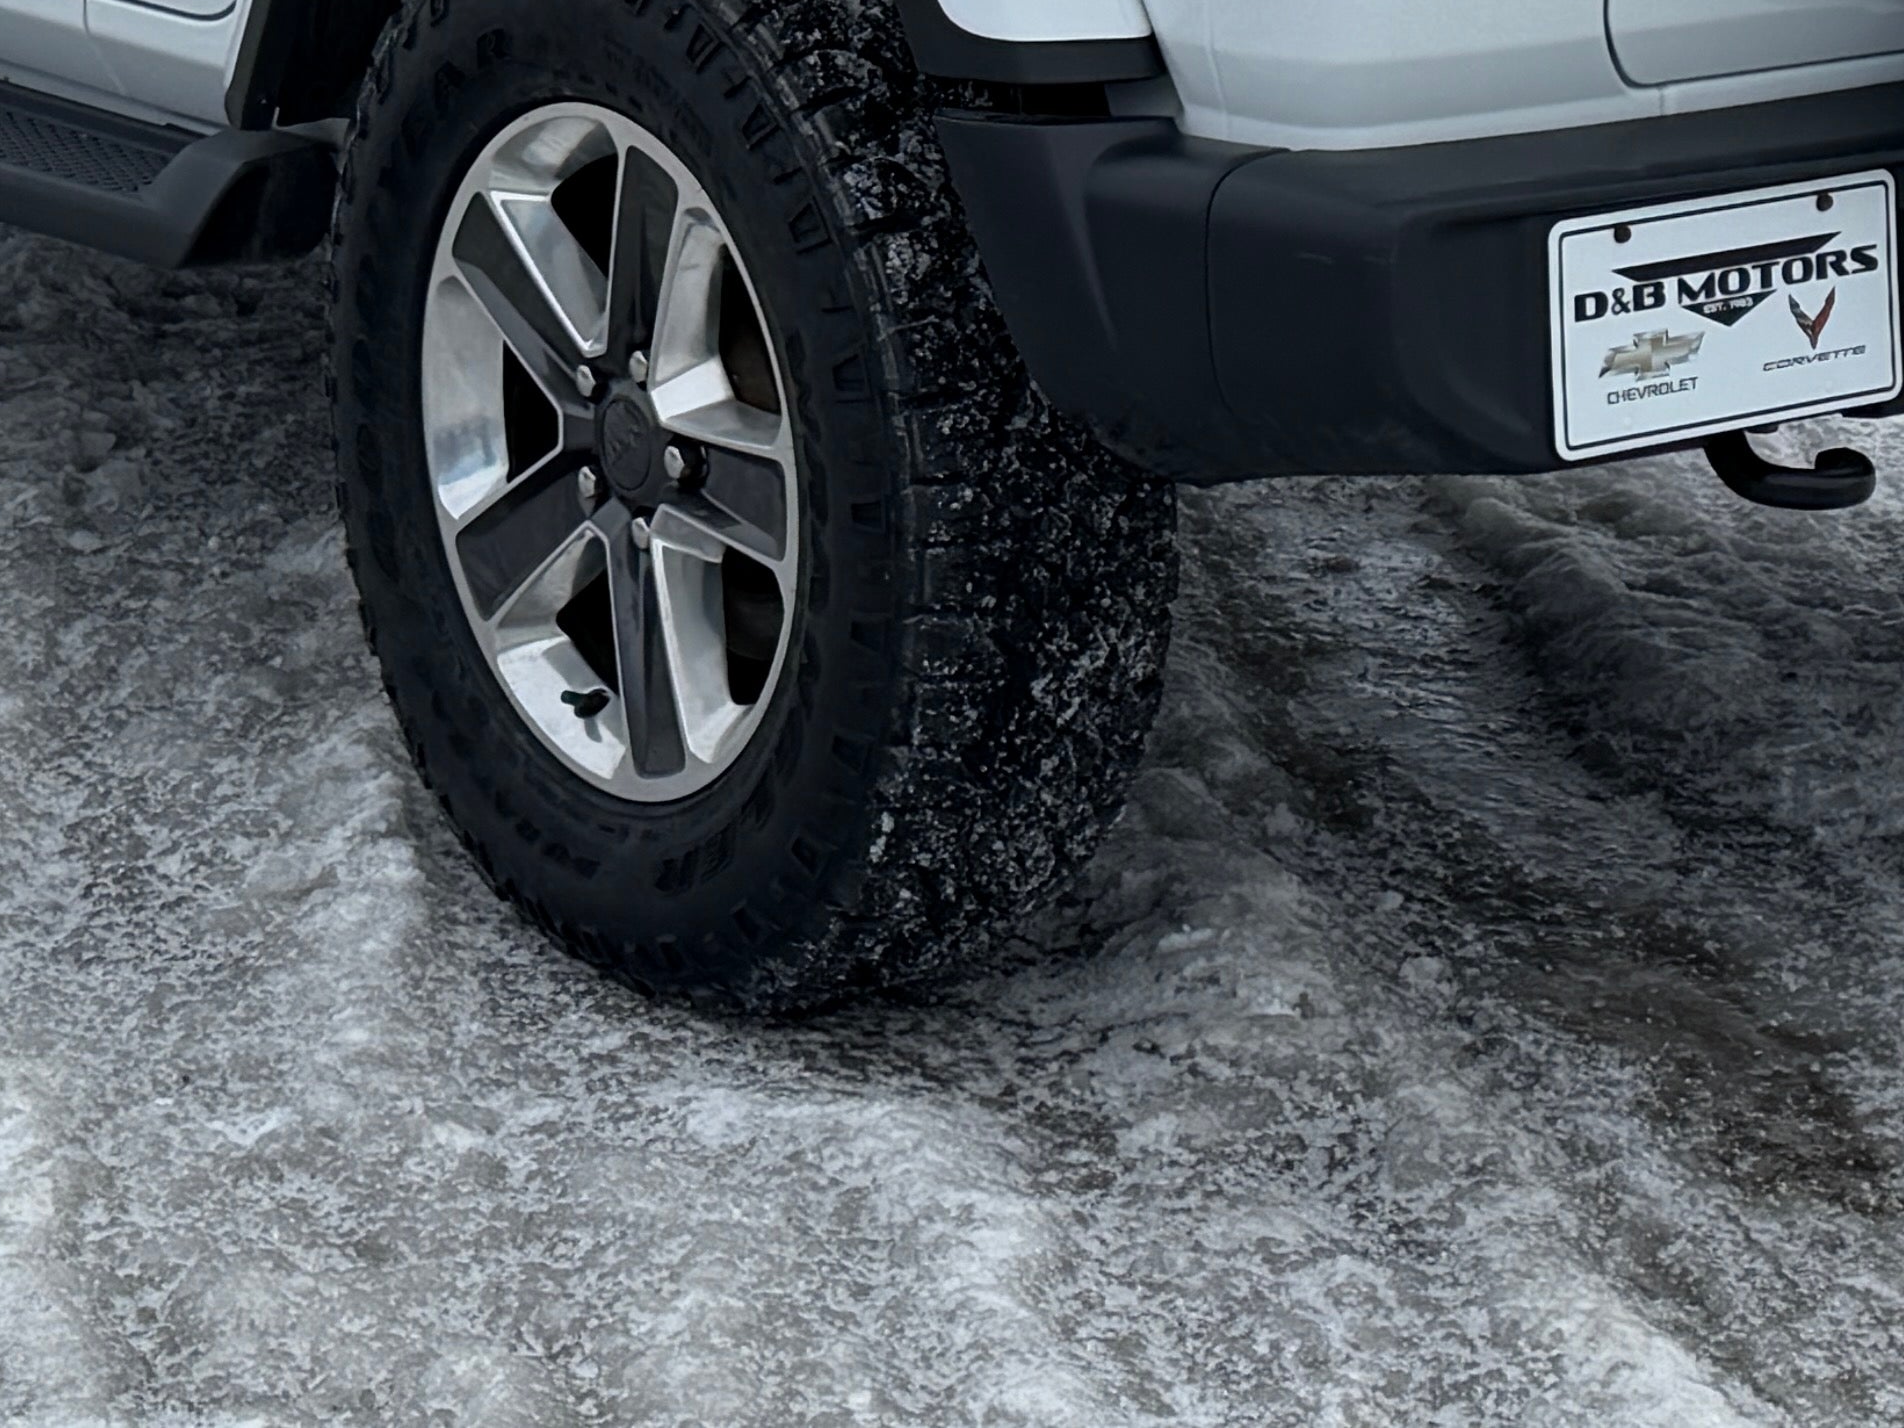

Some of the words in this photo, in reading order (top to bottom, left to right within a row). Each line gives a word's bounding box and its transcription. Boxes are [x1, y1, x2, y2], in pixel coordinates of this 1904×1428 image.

[1574, 282, 1666, 323] D&B
[1677, 244, 1879, 306] MOTORS
[1762, 344, 1866, 372] CORVETTE
[1606, 376, 1699, 405] CHEVROLET
